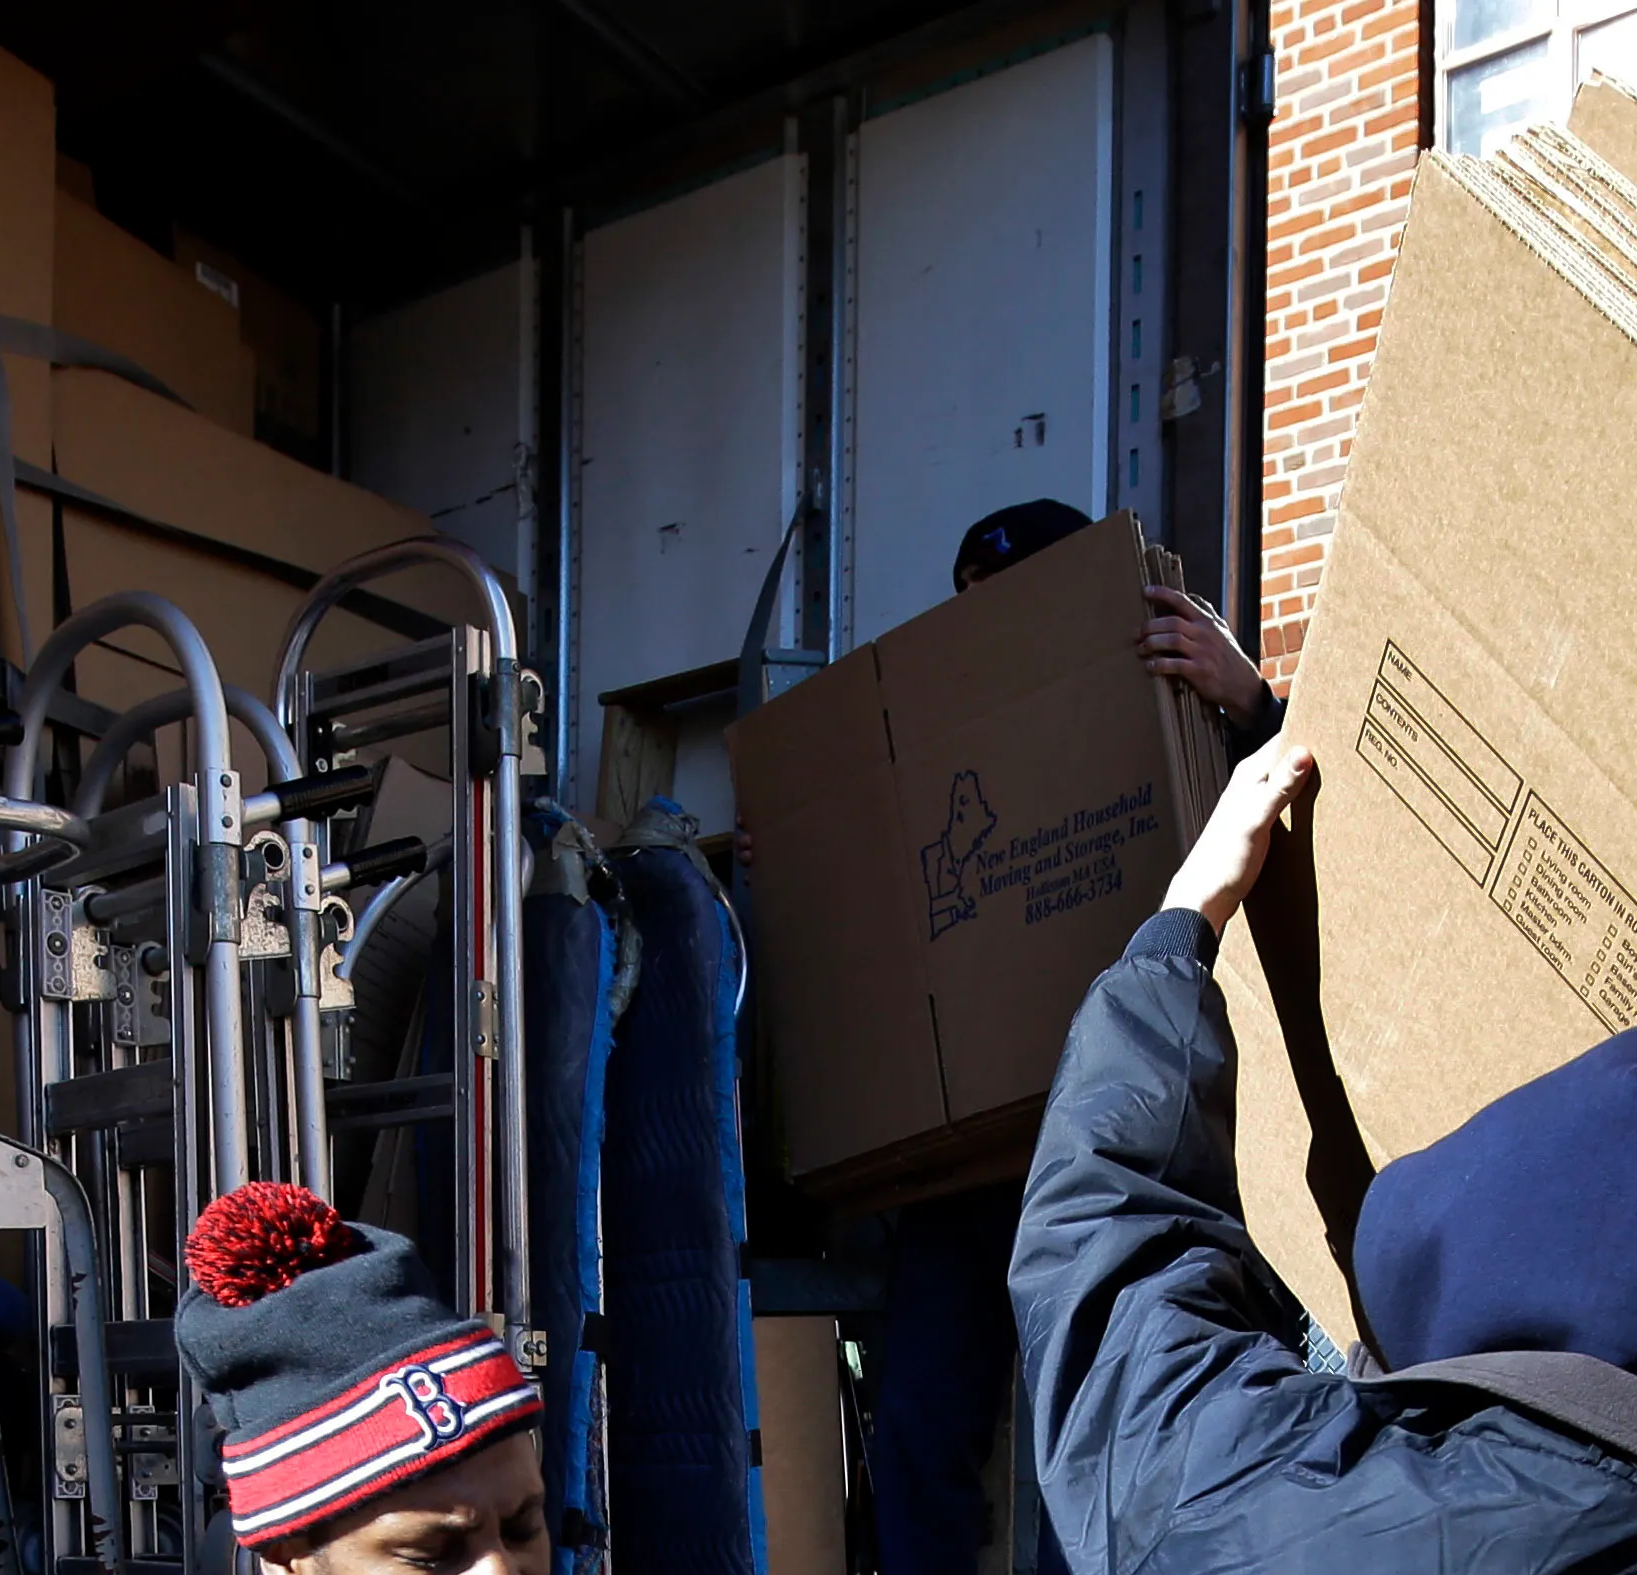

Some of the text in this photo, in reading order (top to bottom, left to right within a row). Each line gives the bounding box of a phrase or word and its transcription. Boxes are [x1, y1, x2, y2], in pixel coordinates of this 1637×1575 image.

[1387, 651, 1414, 682] NAME
[1375, 692, 1419, 742] CONTENTS
[976, 782, 1152, 874] New England Household
[979, 814, 1158, 898] Moving and Storage, Inc.
[1527, 808, 1558, 844] PLACE
[1557, 838, 1579, 867] THIS
[1578, 861, 1616, 907] CARTON
[1613, 901, 1627, 918] IN
[1541, 850, 1592, 910] Living room
[1520, 900, 1550, 935] Master
[1525, 888, 1559, 928] Kitchen
[1531, 876, 1573, 926] Bathroom
[1536, 863, 1588, 924] Dining room
[1540, 941, 1564, 970] room
[1598, 989, 1631, 1026] Garage
[1604, 976, 1634, 1012] Family
[379, 1364, 466, 1453] B
